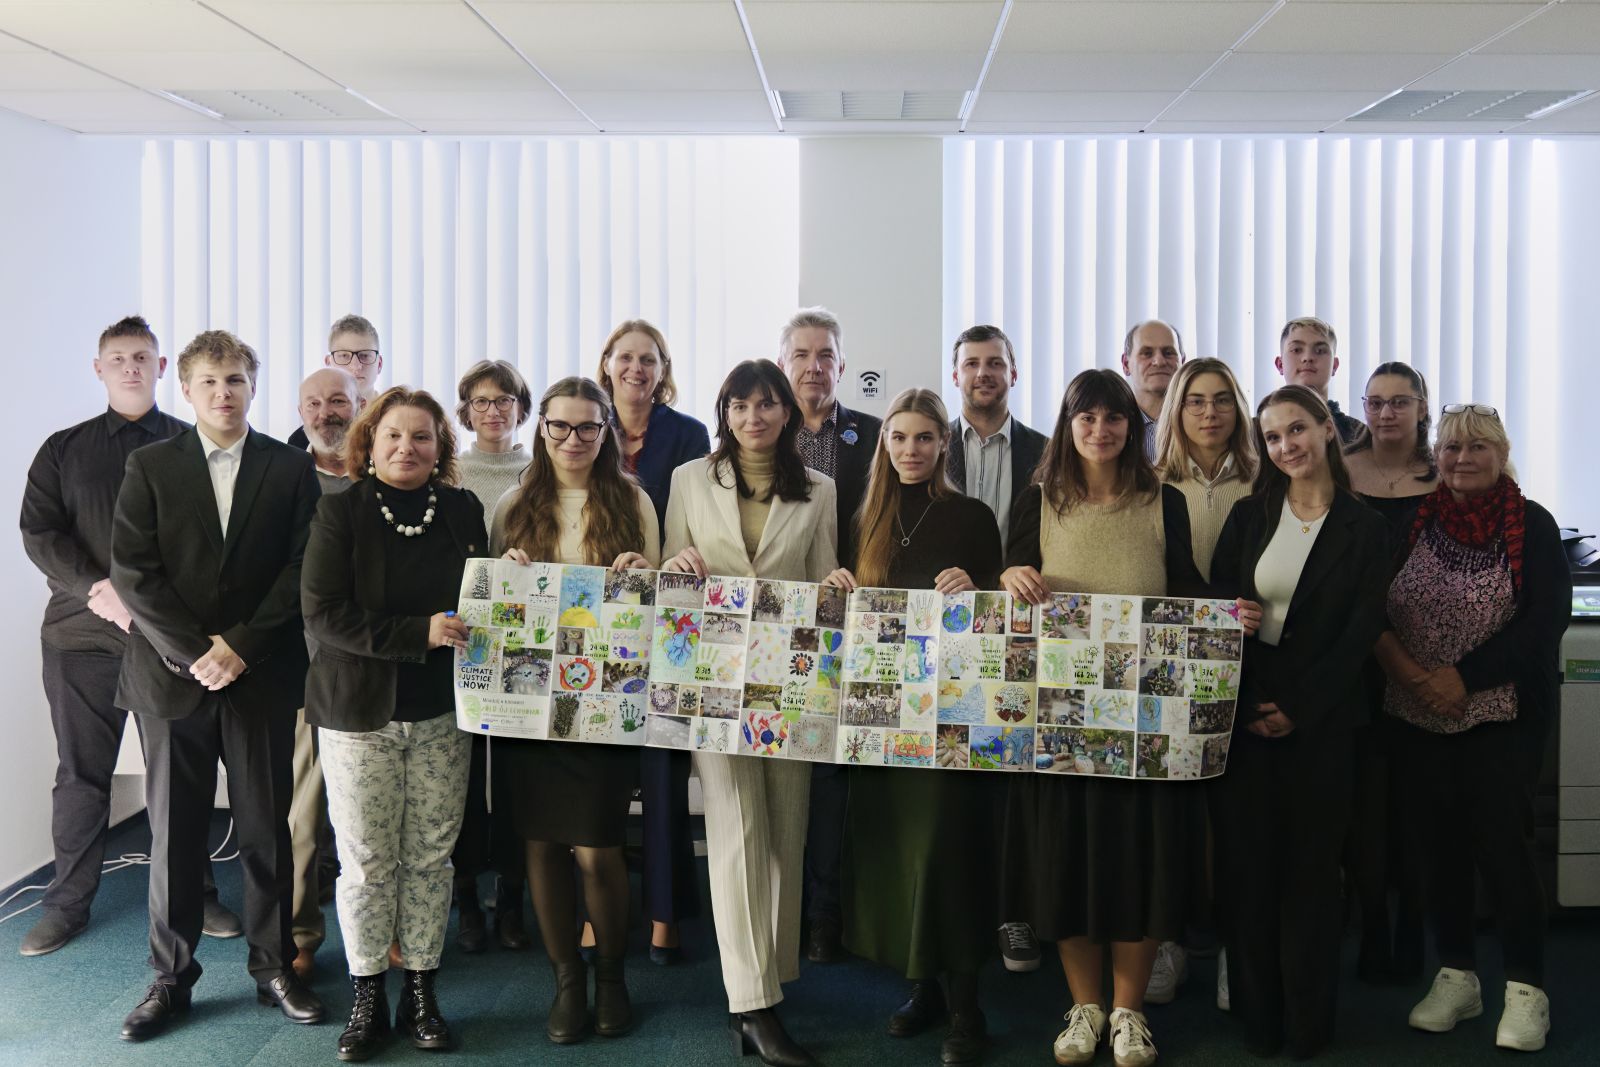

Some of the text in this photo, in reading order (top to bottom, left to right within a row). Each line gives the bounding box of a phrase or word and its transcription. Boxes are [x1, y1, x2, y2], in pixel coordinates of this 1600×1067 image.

[461, 667, 493, 675] CLIMATE
[462, 674, 491, 682] JUSTICE
[463, 680, 490, 691] NOW!
